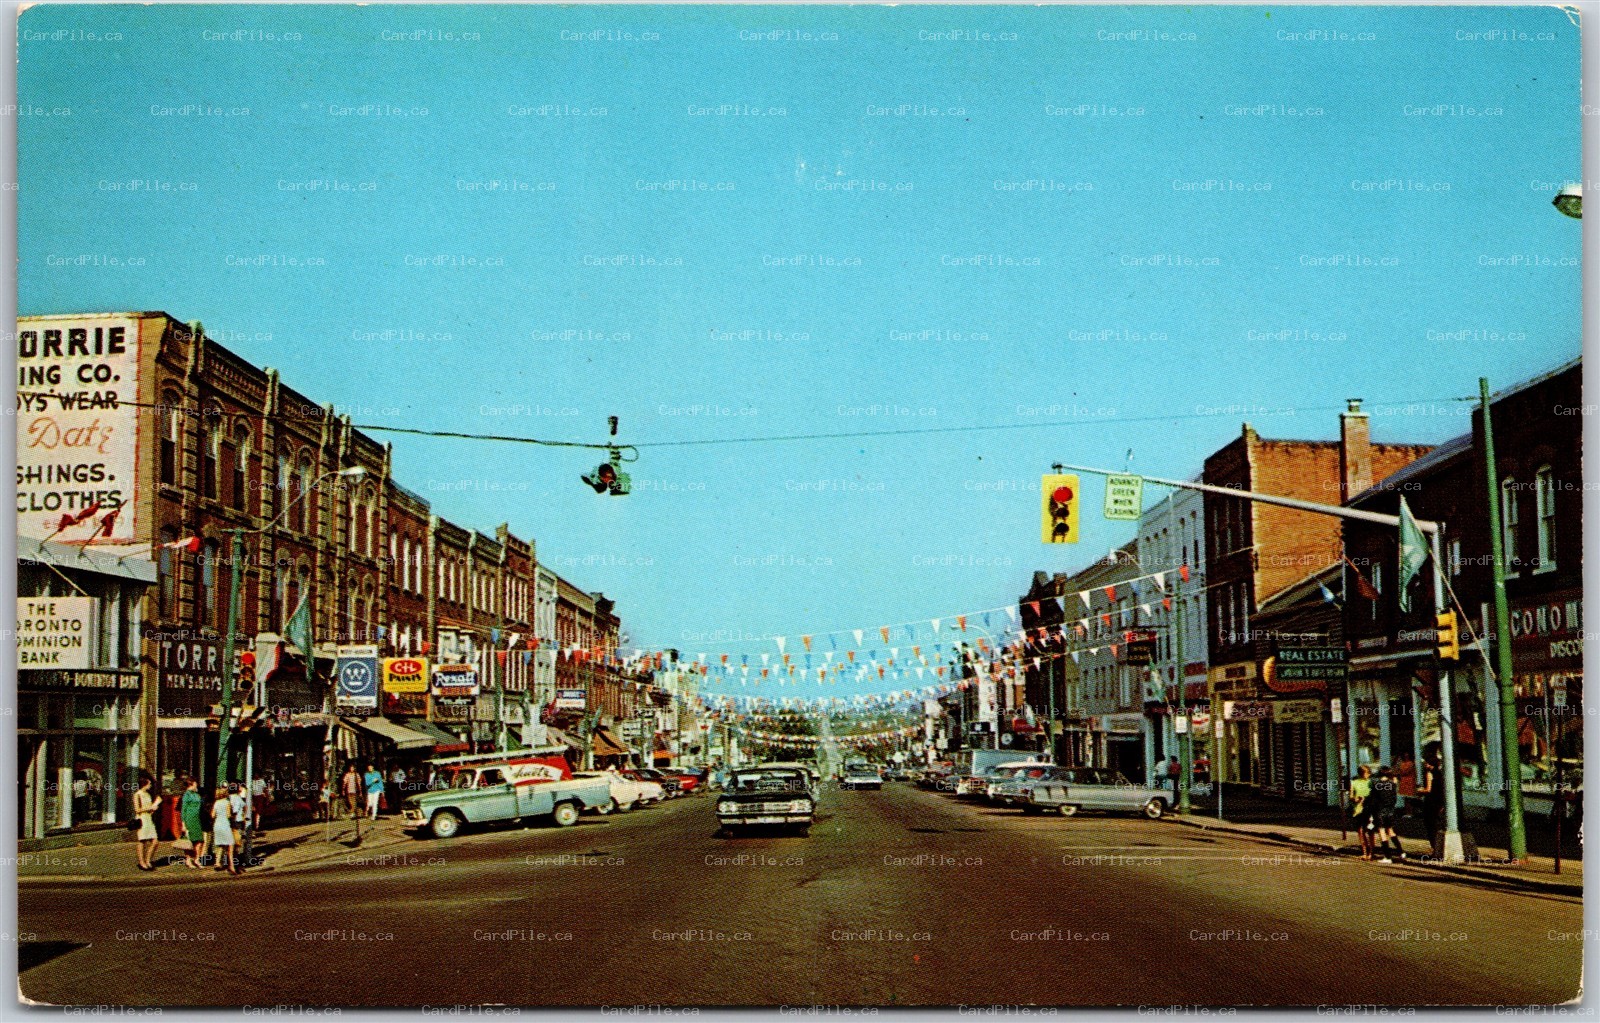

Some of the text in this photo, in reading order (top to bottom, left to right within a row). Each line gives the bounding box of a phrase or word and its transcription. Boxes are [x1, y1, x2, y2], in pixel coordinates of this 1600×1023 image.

[19, 363, 121, 385] ING CO.
[58, 390, 120, 411] WEAR
[27, 603, 57, 616] THE
[21, 651, 60, 664] BANK
[1279, 650, 1345, 661] REAL ESTATE
